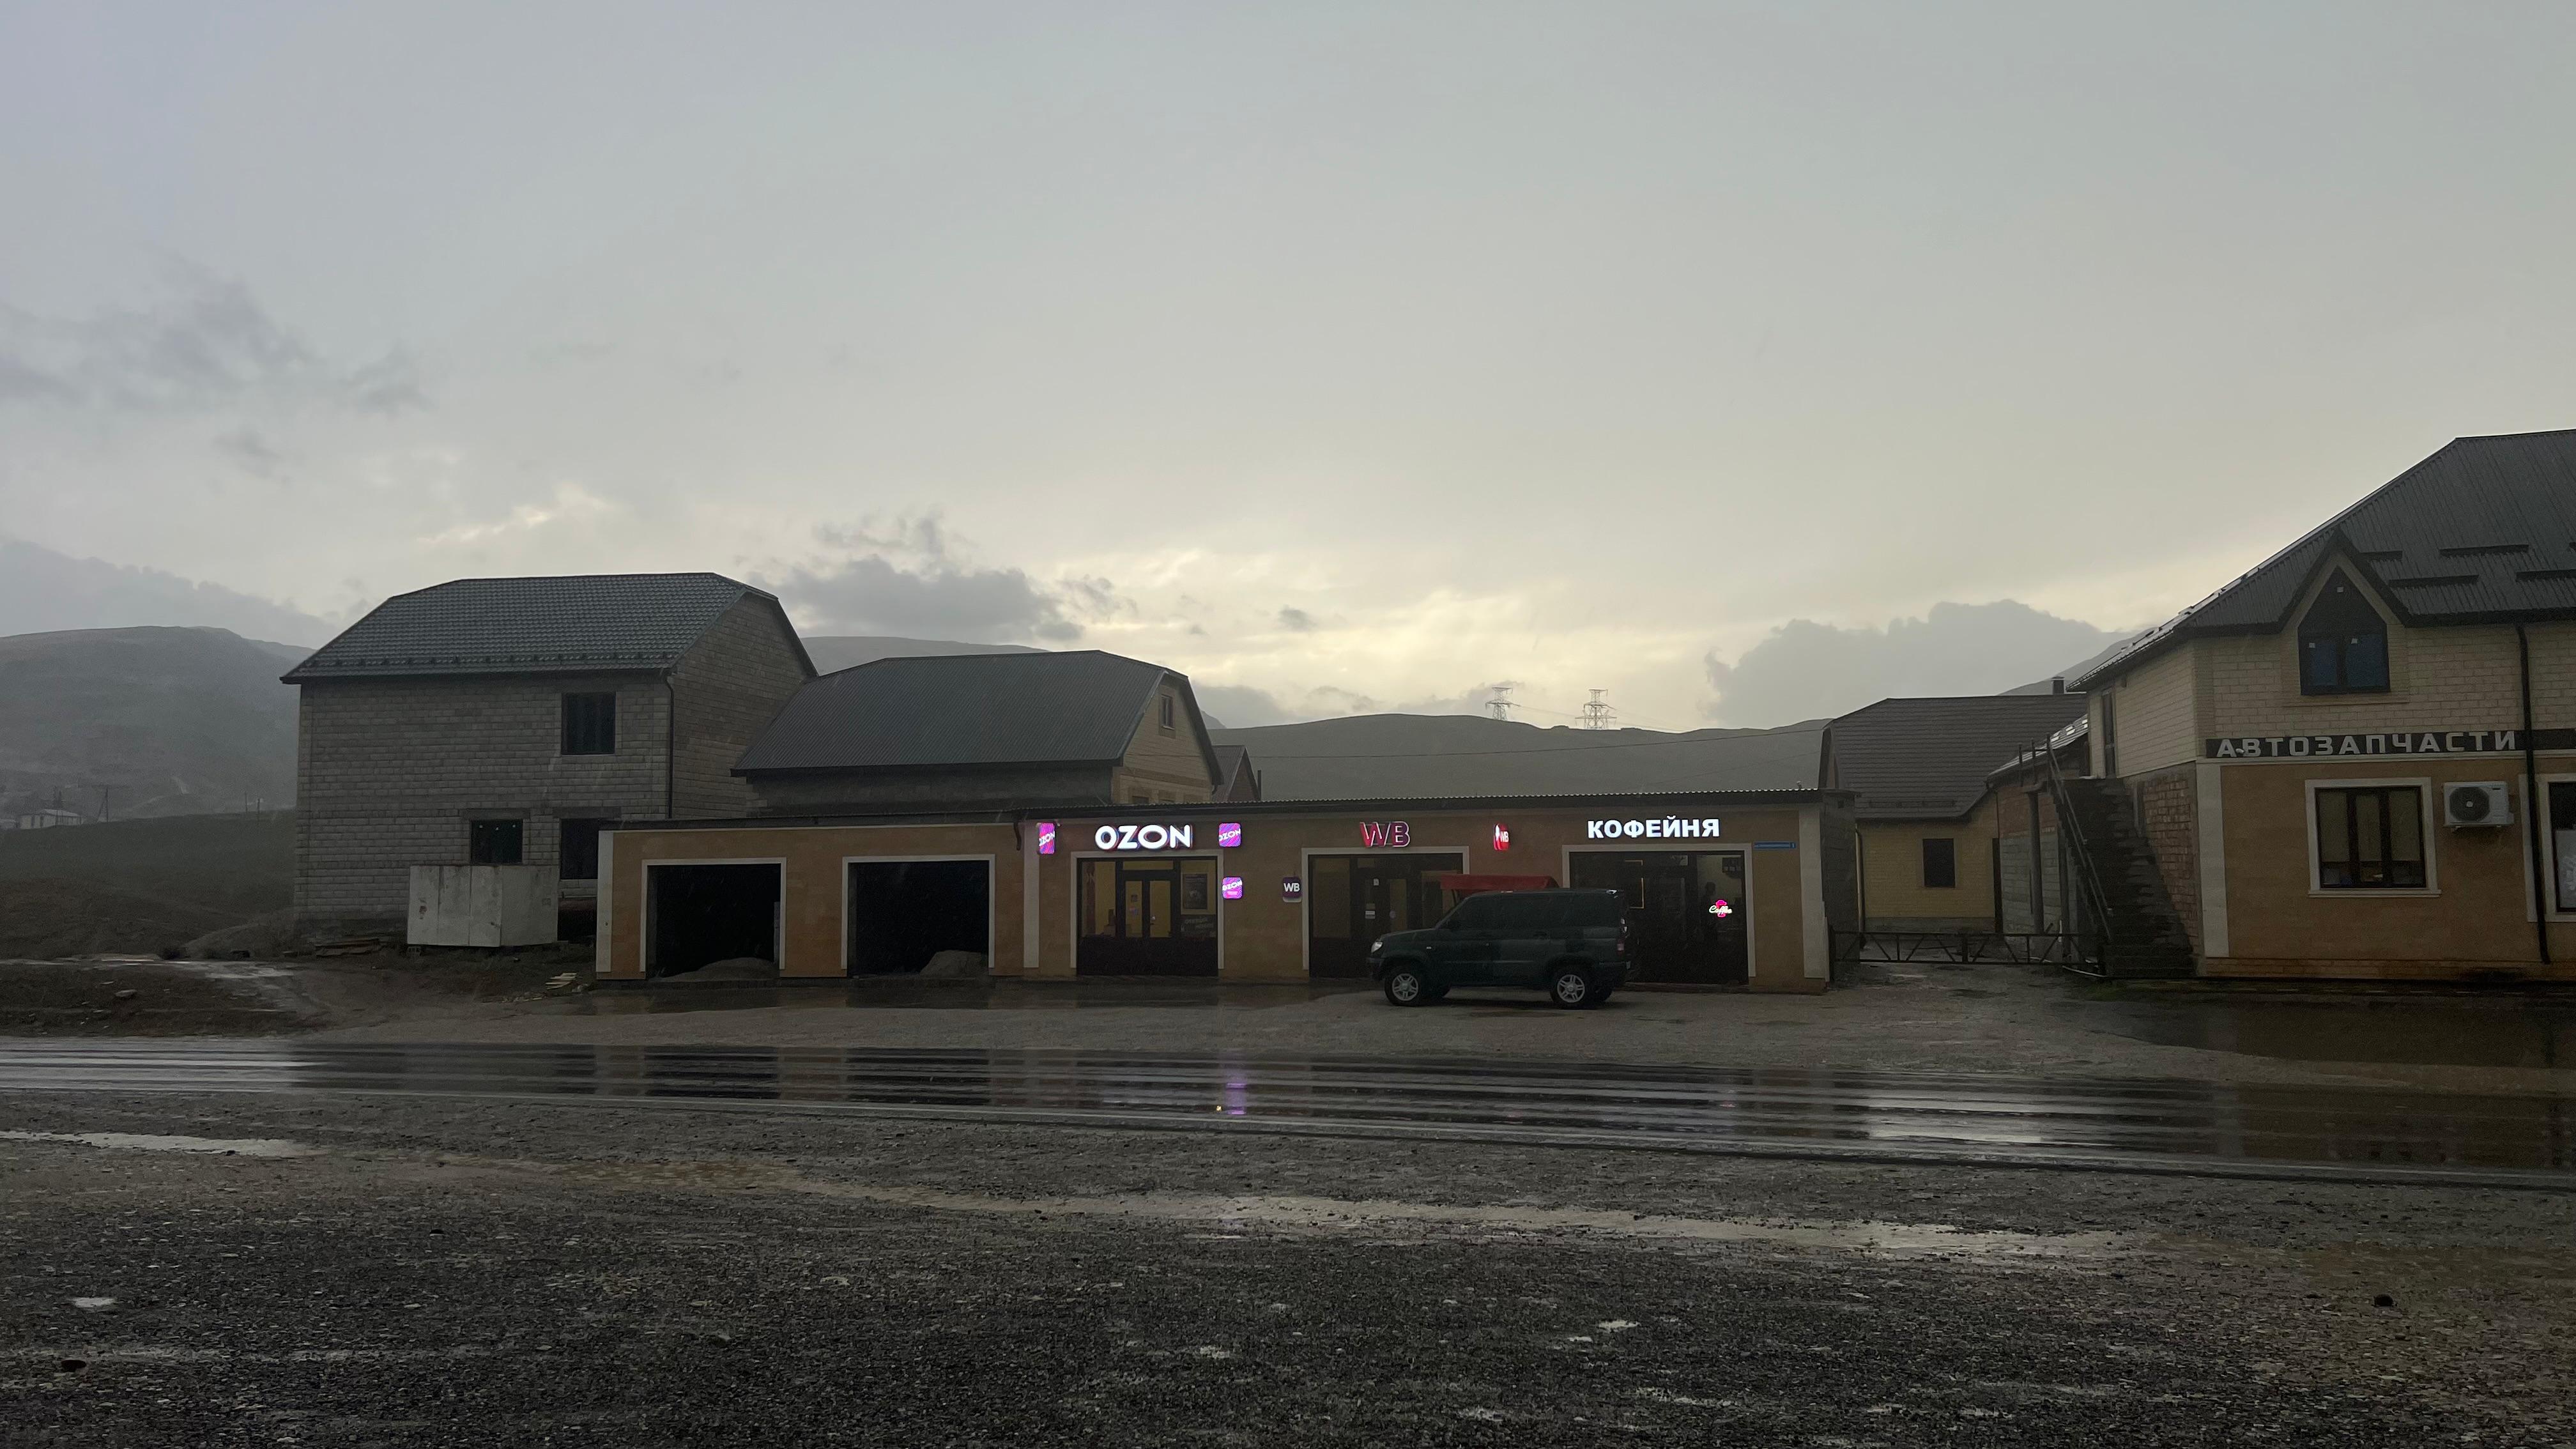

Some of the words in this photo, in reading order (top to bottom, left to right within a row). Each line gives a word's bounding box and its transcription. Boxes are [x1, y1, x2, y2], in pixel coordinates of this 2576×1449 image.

[2216, 730, 2516, 758] АВТОЗАПЧАСТИ
[1094, 824, 1193, 850] OZON
[1359, 821, 1411, 848] WB
[1587, 815, 1721, 839] КОФЕЙНЯ
[1283, 882, 1300, 892] WB
